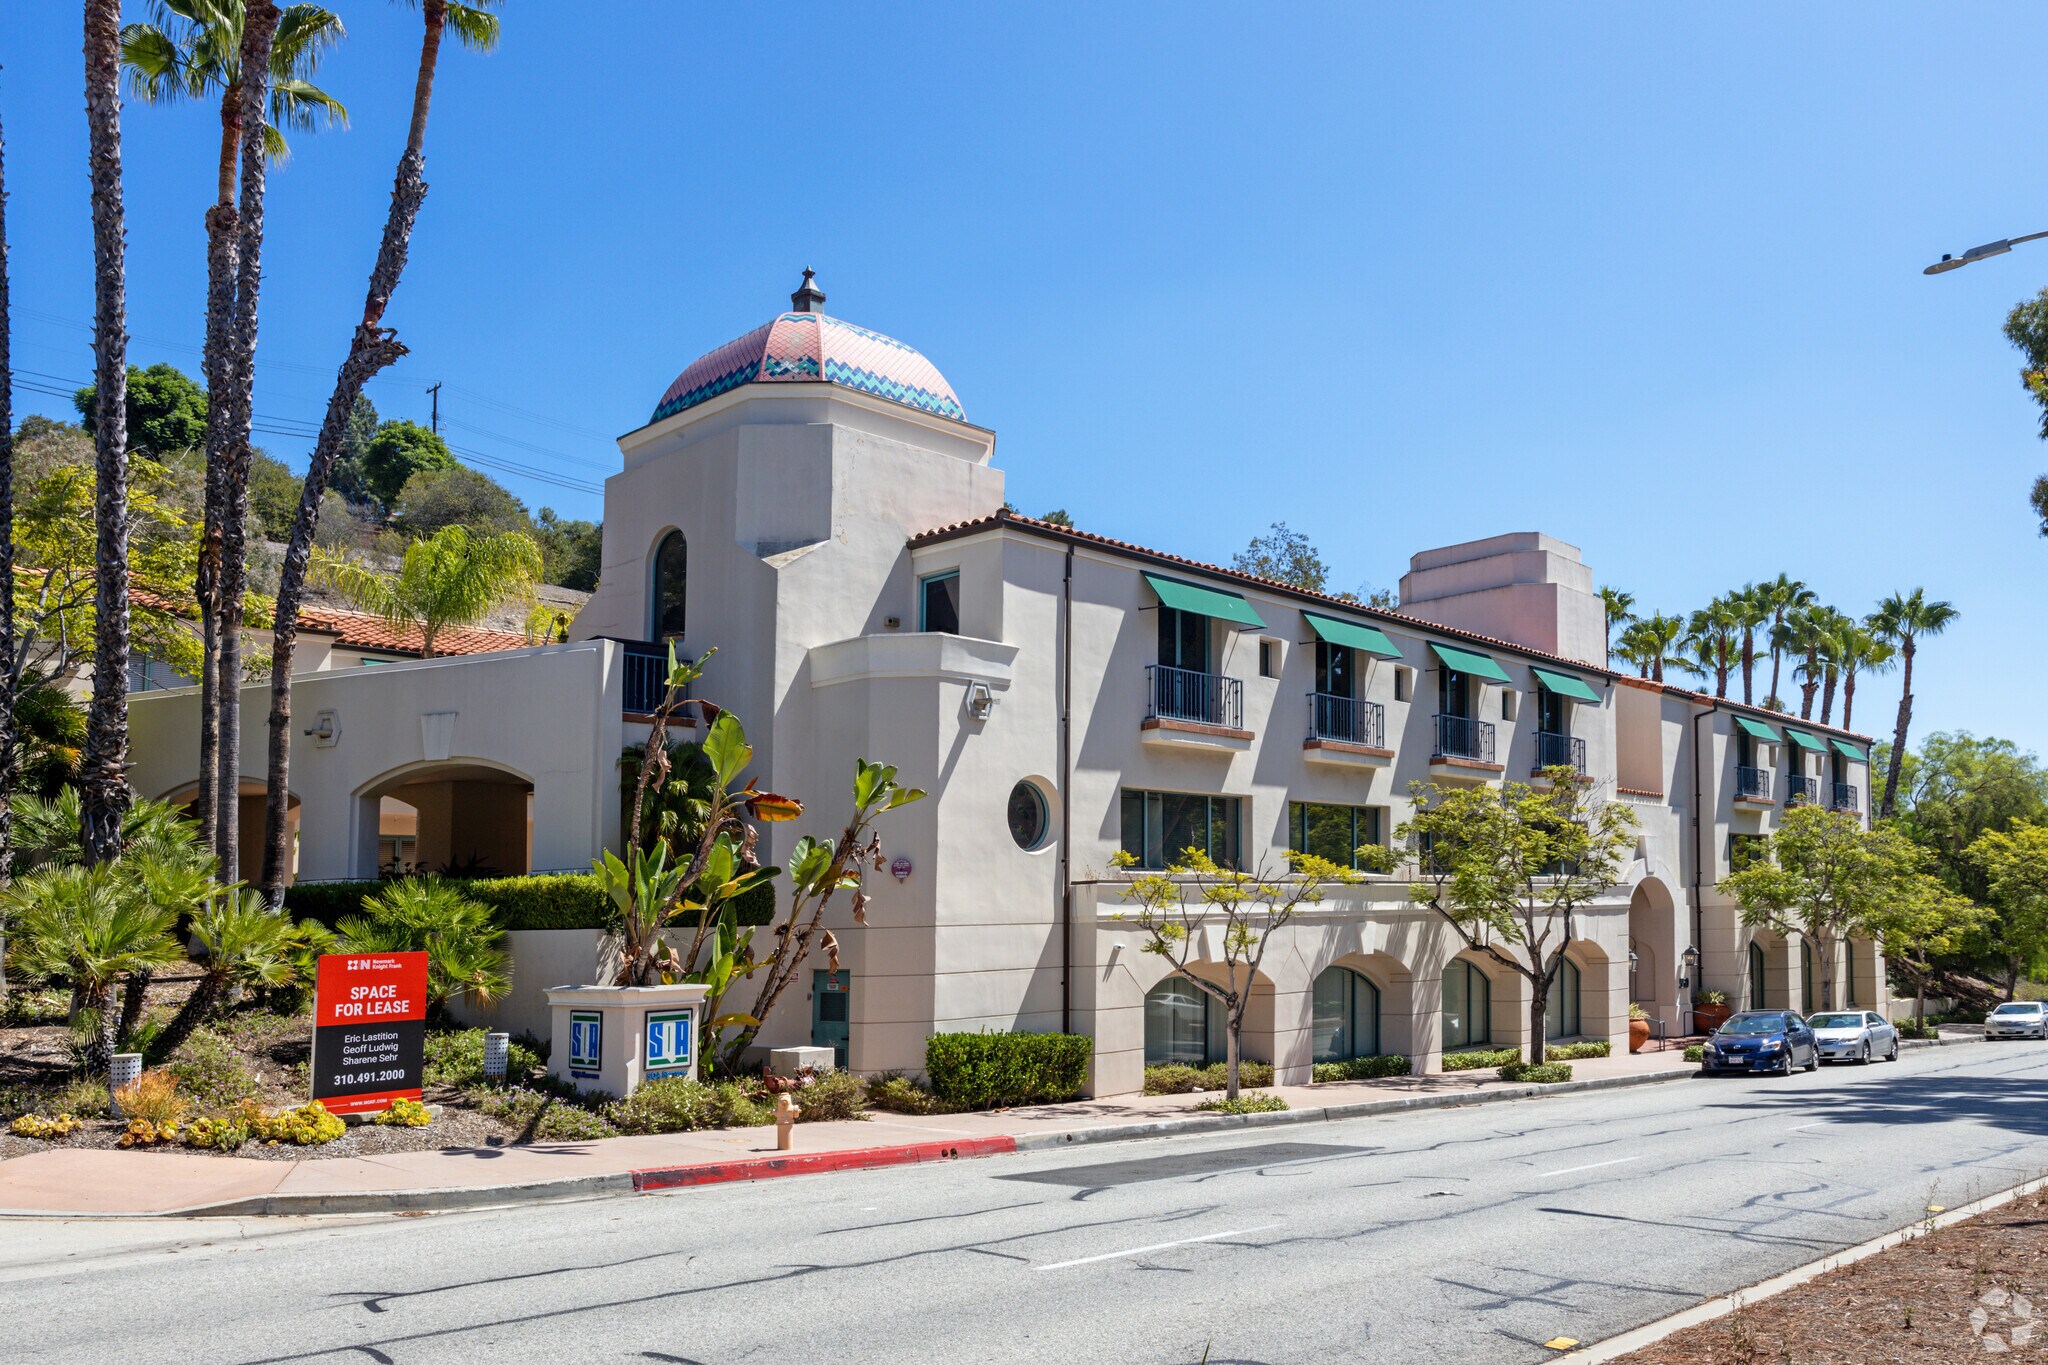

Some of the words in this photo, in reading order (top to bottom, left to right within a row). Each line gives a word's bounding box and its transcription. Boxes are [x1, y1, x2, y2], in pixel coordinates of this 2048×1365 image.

[350, 985, 397, 1000] SPACE
[335, 1003, 363, 1017] FOR
[367, 1000, 410, 1015] LEASE
[344, 1034, 361, 1043] Eric
[362, 1032, 399, 1042] Lastition
[649, 1020, 689, 1064] SQA
[343, 1044, 367, 1055] Geoff
[368, 1042, 399, 1054] Ludwig
[342, 1055, 378, 1066] Sharene
[379, 1053, 399, 1062] Sehr
[333, 1069, 405, 1086] 310.491.2000
